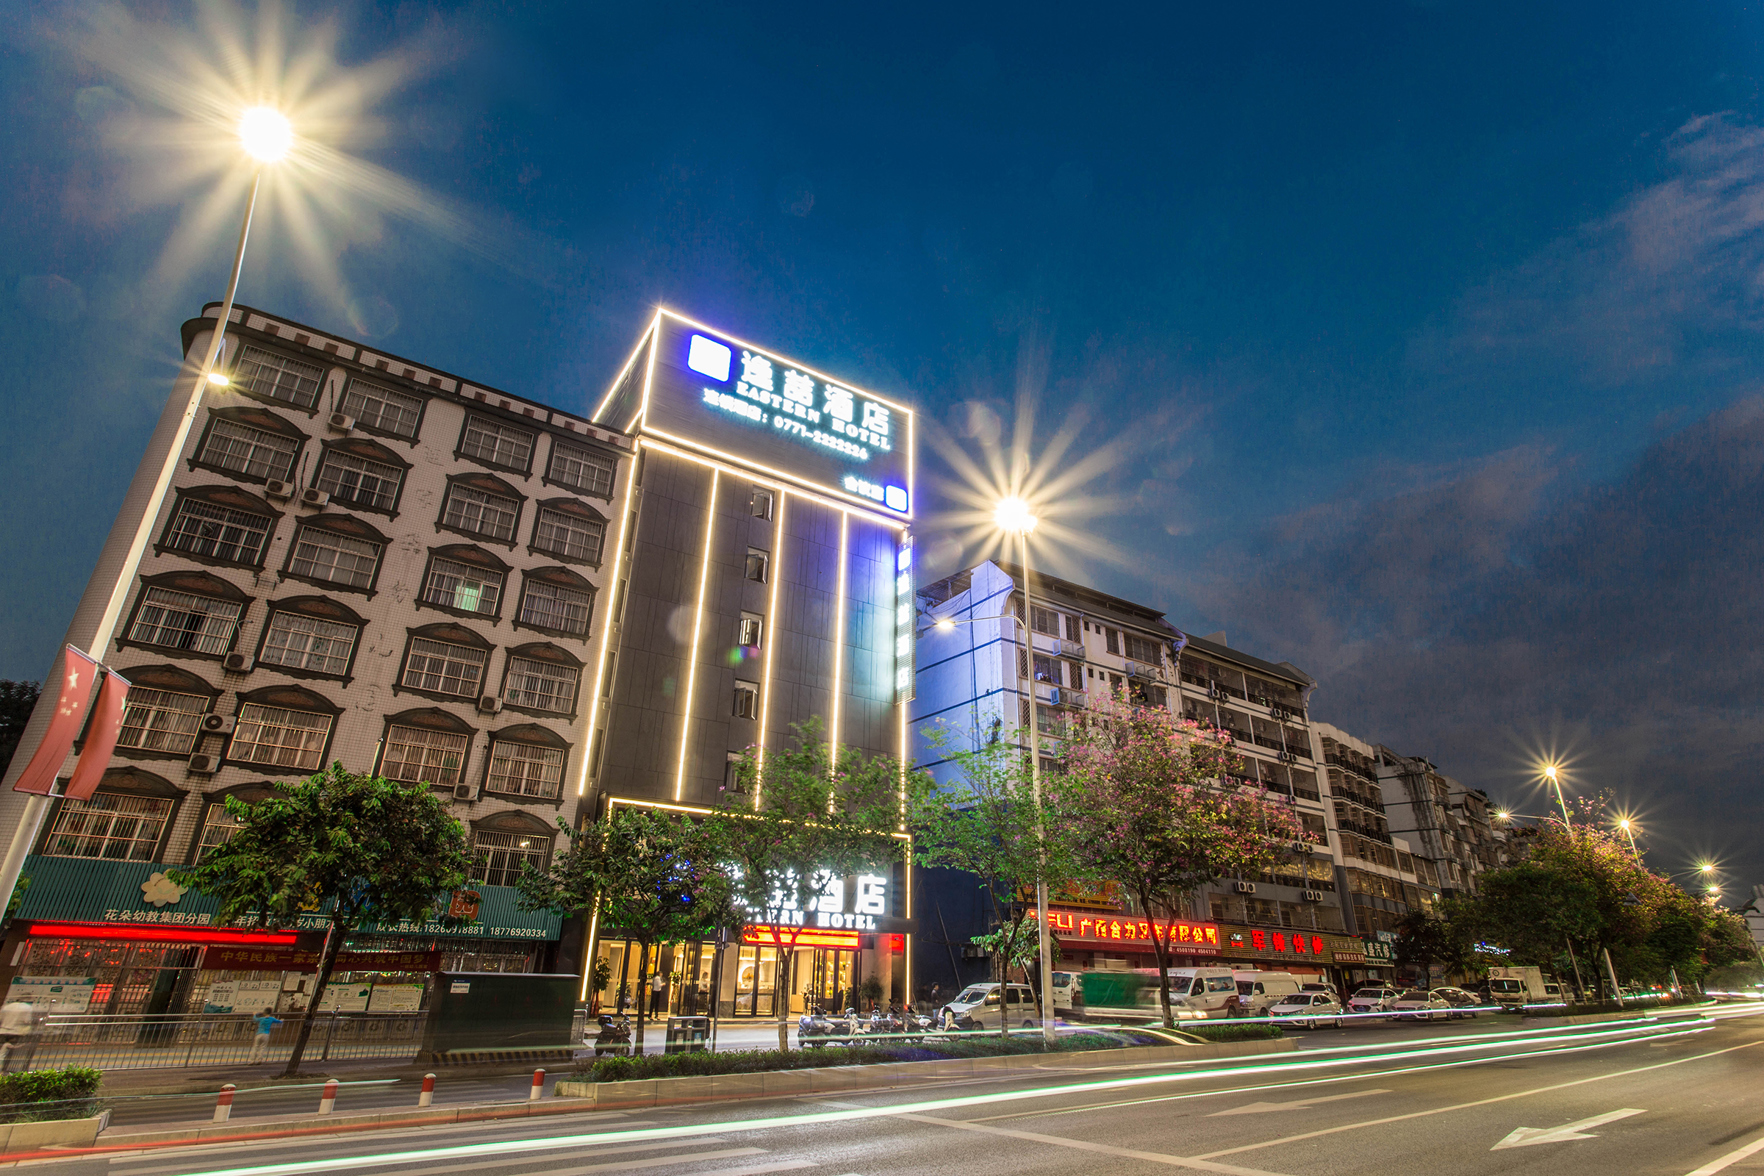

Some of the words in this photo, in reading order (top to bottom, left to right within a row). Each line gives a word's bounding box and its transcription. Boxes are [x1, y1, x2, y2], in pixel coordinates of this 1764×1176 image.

[737, 381, 820, 423] EASTERN
[832, 418, 891, 450] HOTEL
[104, 908, 211, 925] 花朵幼教集团分园
[818, 912, 875, 930] HOTEL
[489, 926, 547, 938] 18776920334
